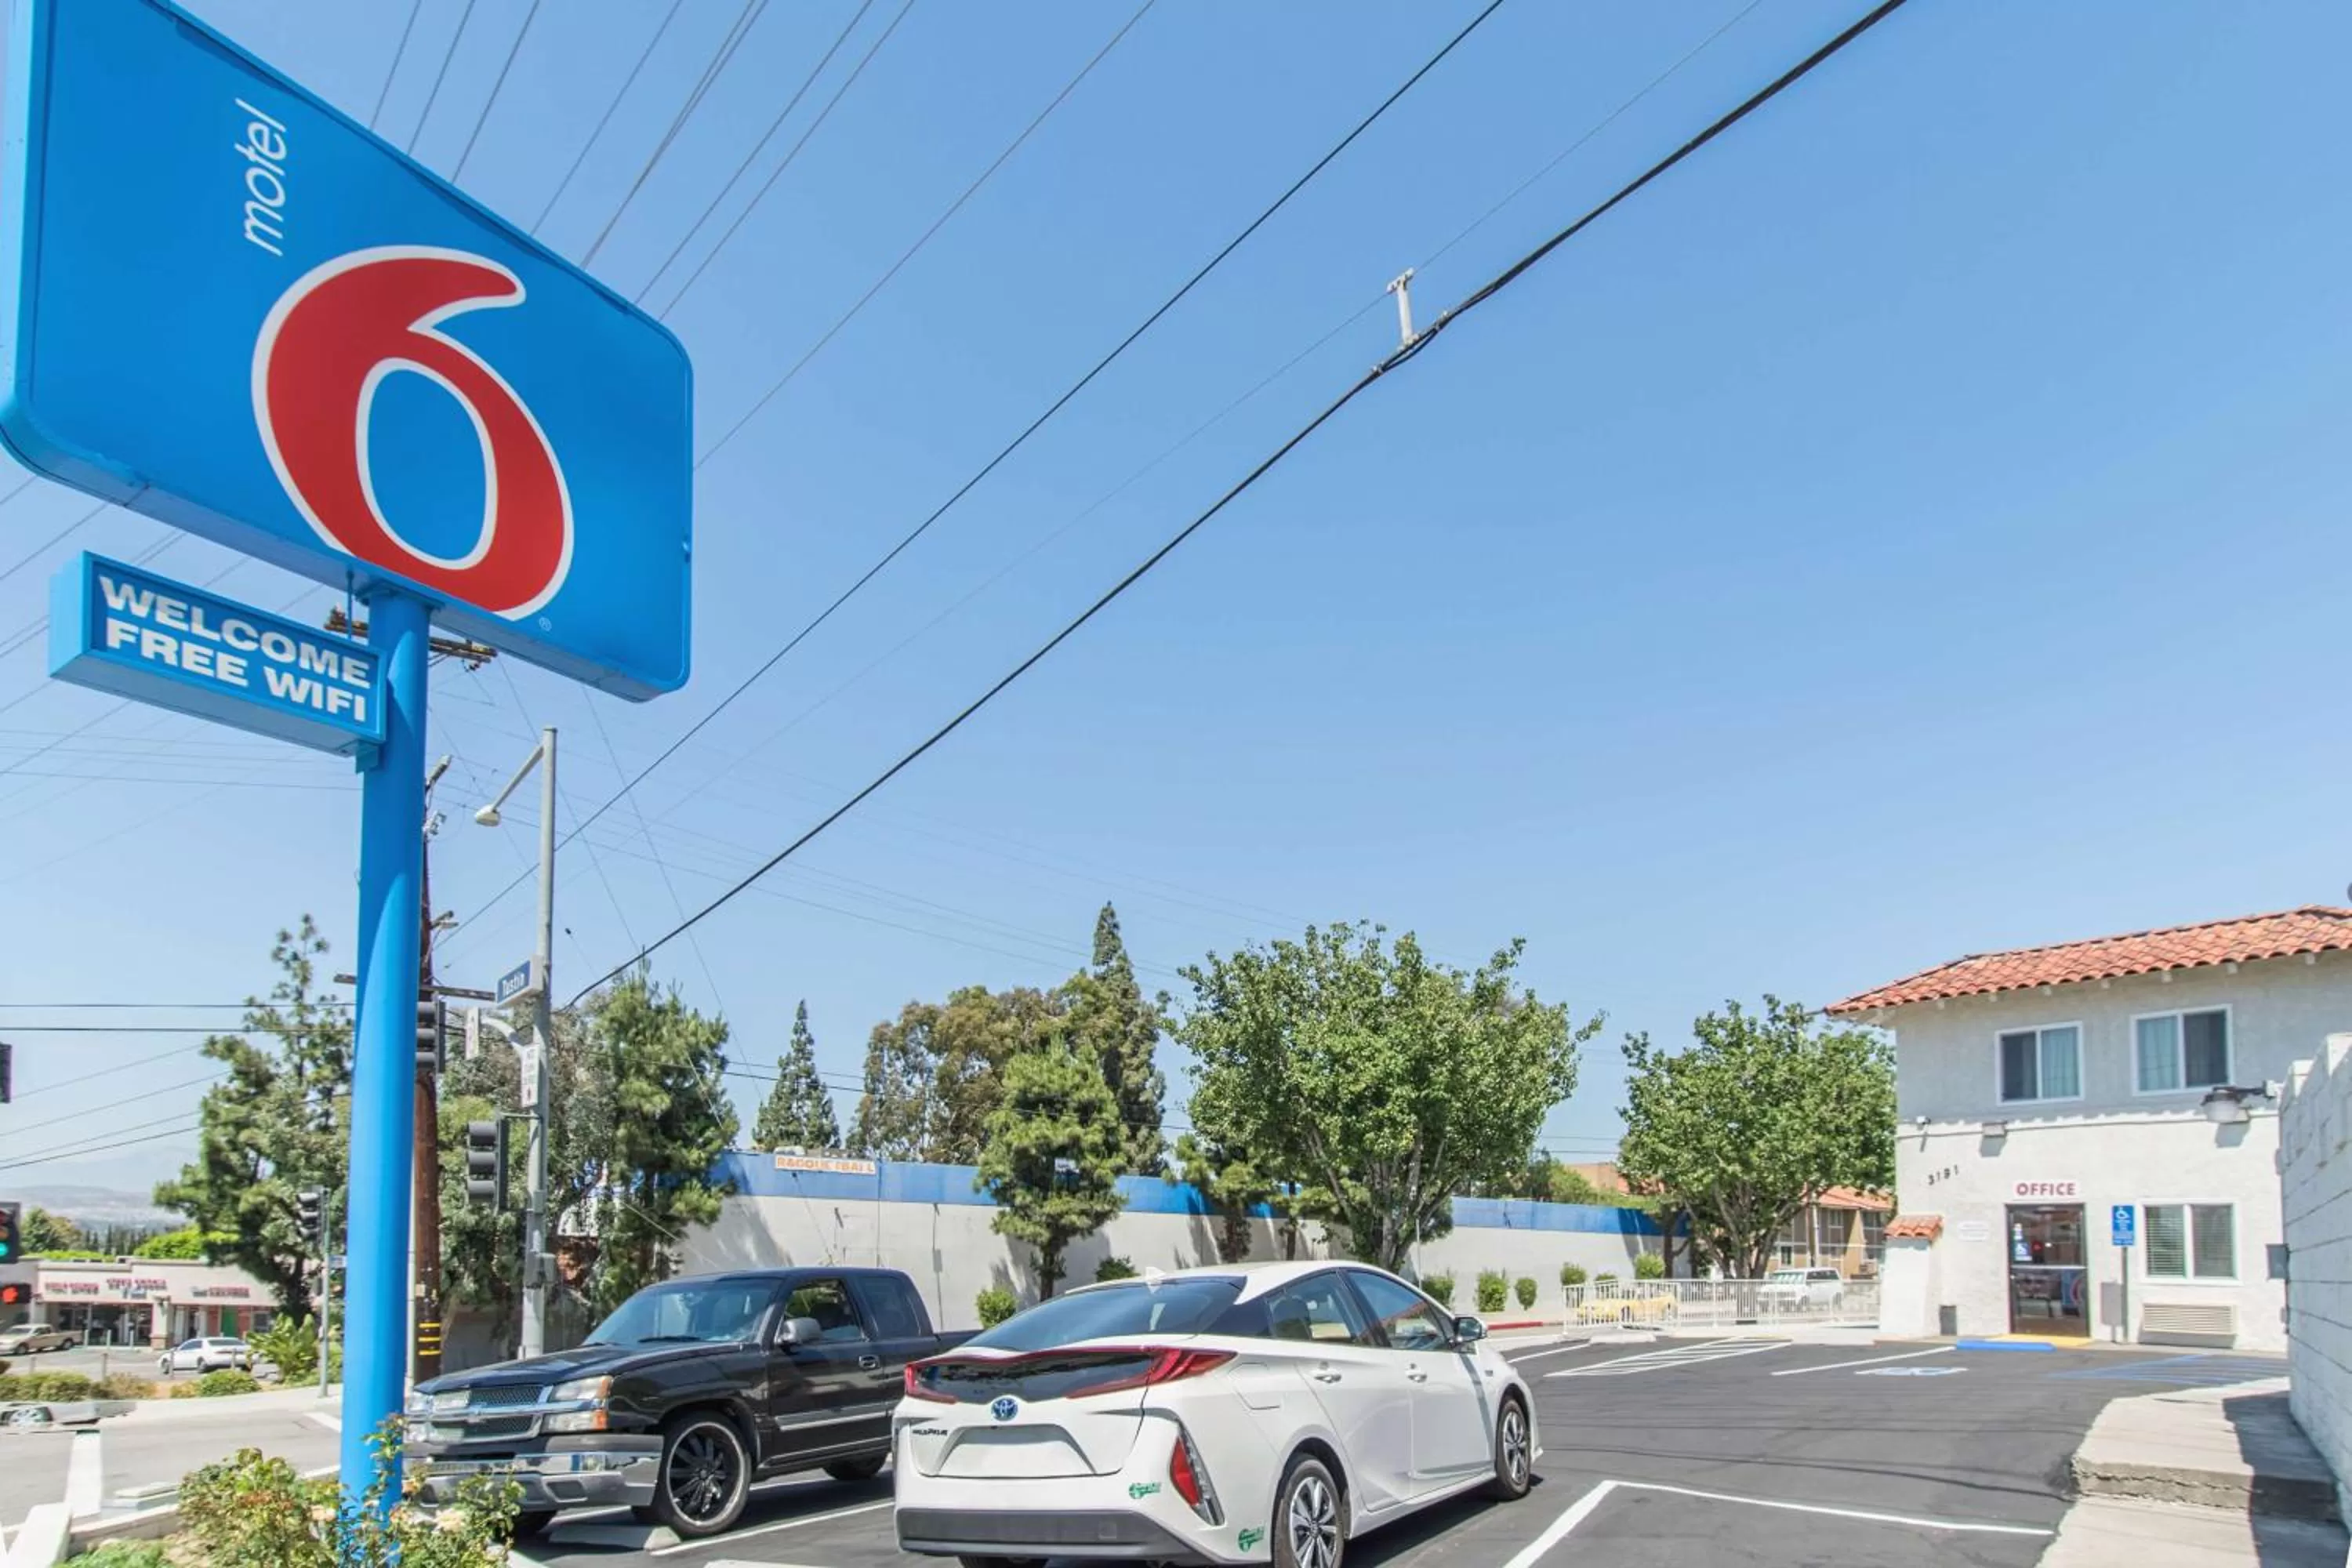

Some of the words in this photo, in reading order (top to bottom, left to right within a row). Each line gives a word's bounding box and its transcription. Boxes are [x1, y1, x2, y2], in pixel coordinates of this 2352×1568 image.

[234, 97, 287, 256] motel
[251, 245, 575, 621] 6
[99, 575, 371, 690] WELCOME
[107, 617, 249, 687] FREE
[263, 666, 366, 722] WIFI
[502, 971, 525, 996] Tustin
[2016, 1182, 2076, 1196] OFFICE
